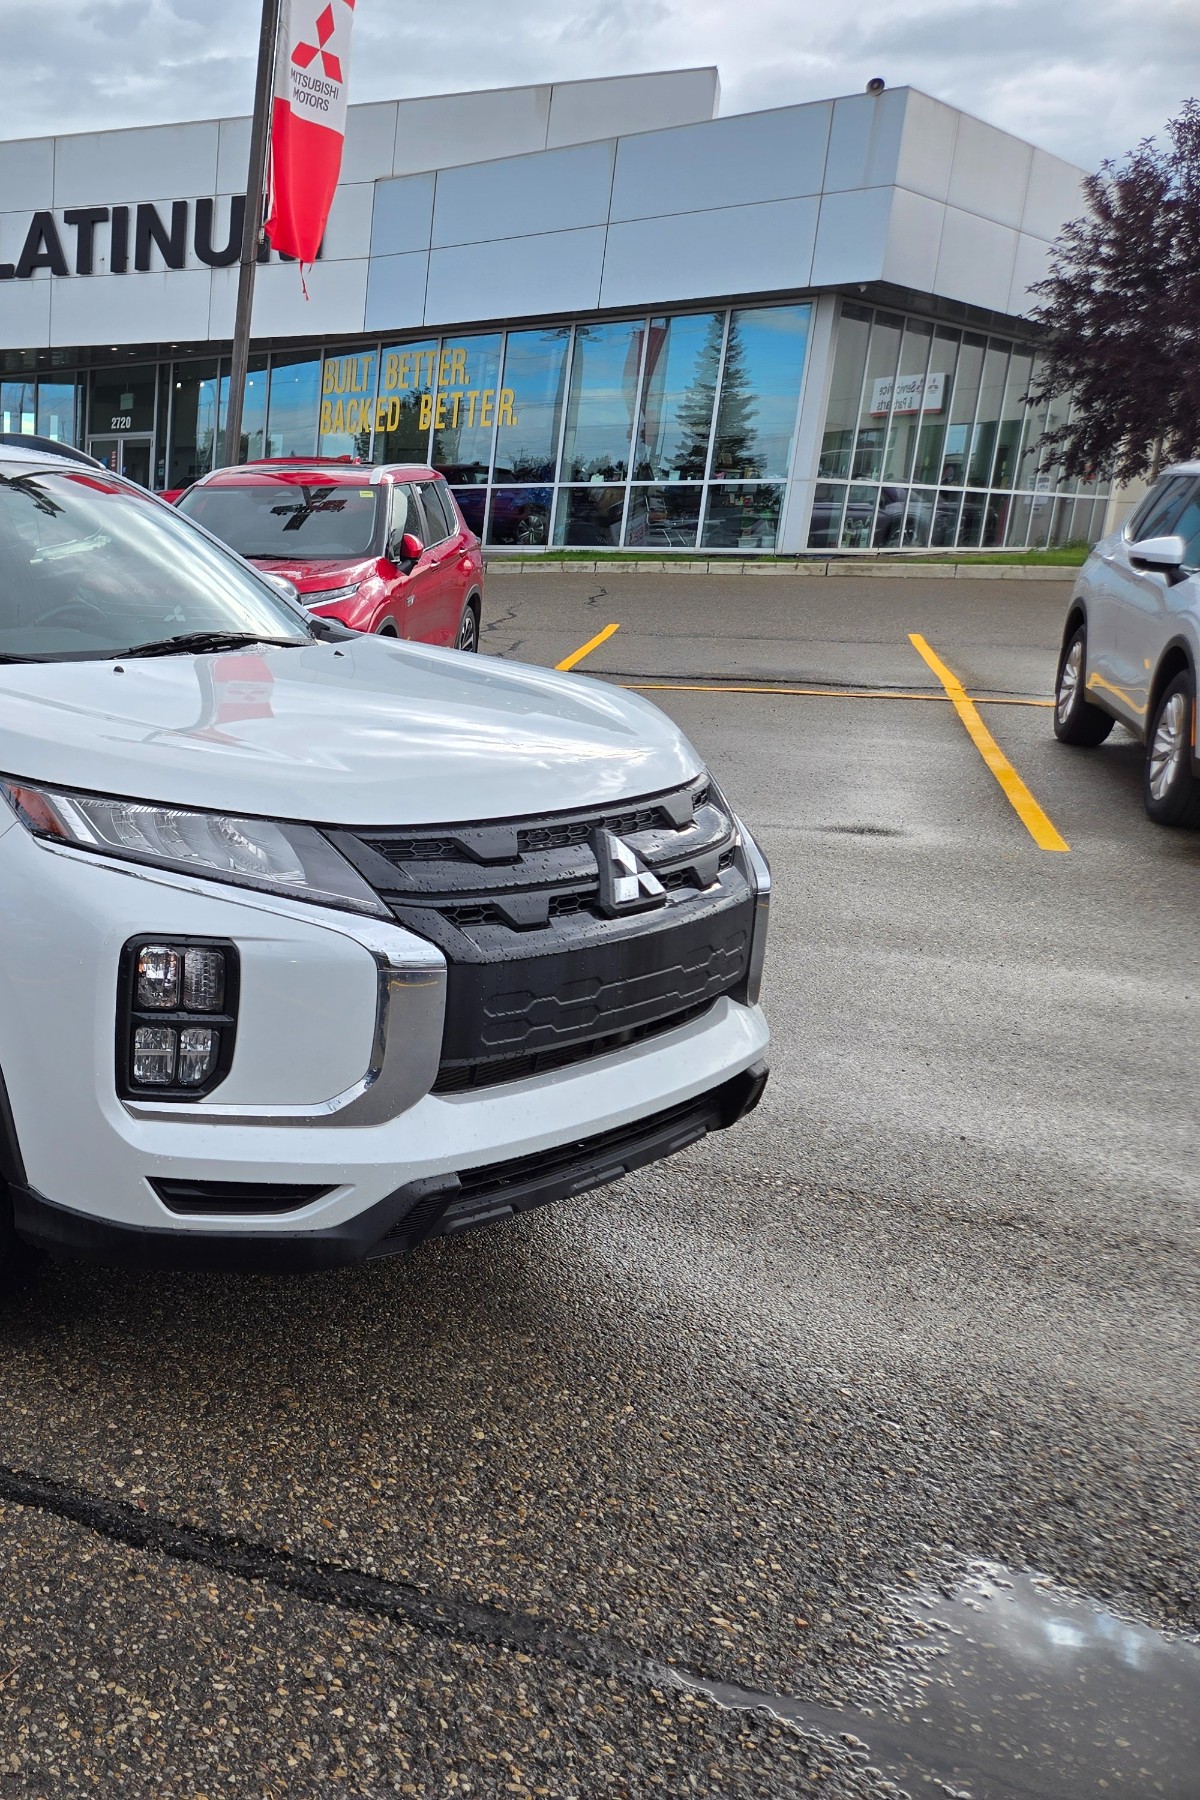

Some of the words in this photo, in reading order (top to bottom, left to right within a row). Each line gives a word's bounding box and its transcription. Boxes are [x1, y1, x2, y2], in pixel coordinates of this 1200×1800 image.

[290, 67, 340, 100] MITSUBISHI
[292, 87, 331, 112] MOTORS
[322, 355, 374, 395] BUILT
[384, 347, 471, 391] BETTER.
[110, 416, 132, 430] 2720
[320, 395, 401, 436] BACKED
[418, 387, 519, 432] BETTER.
